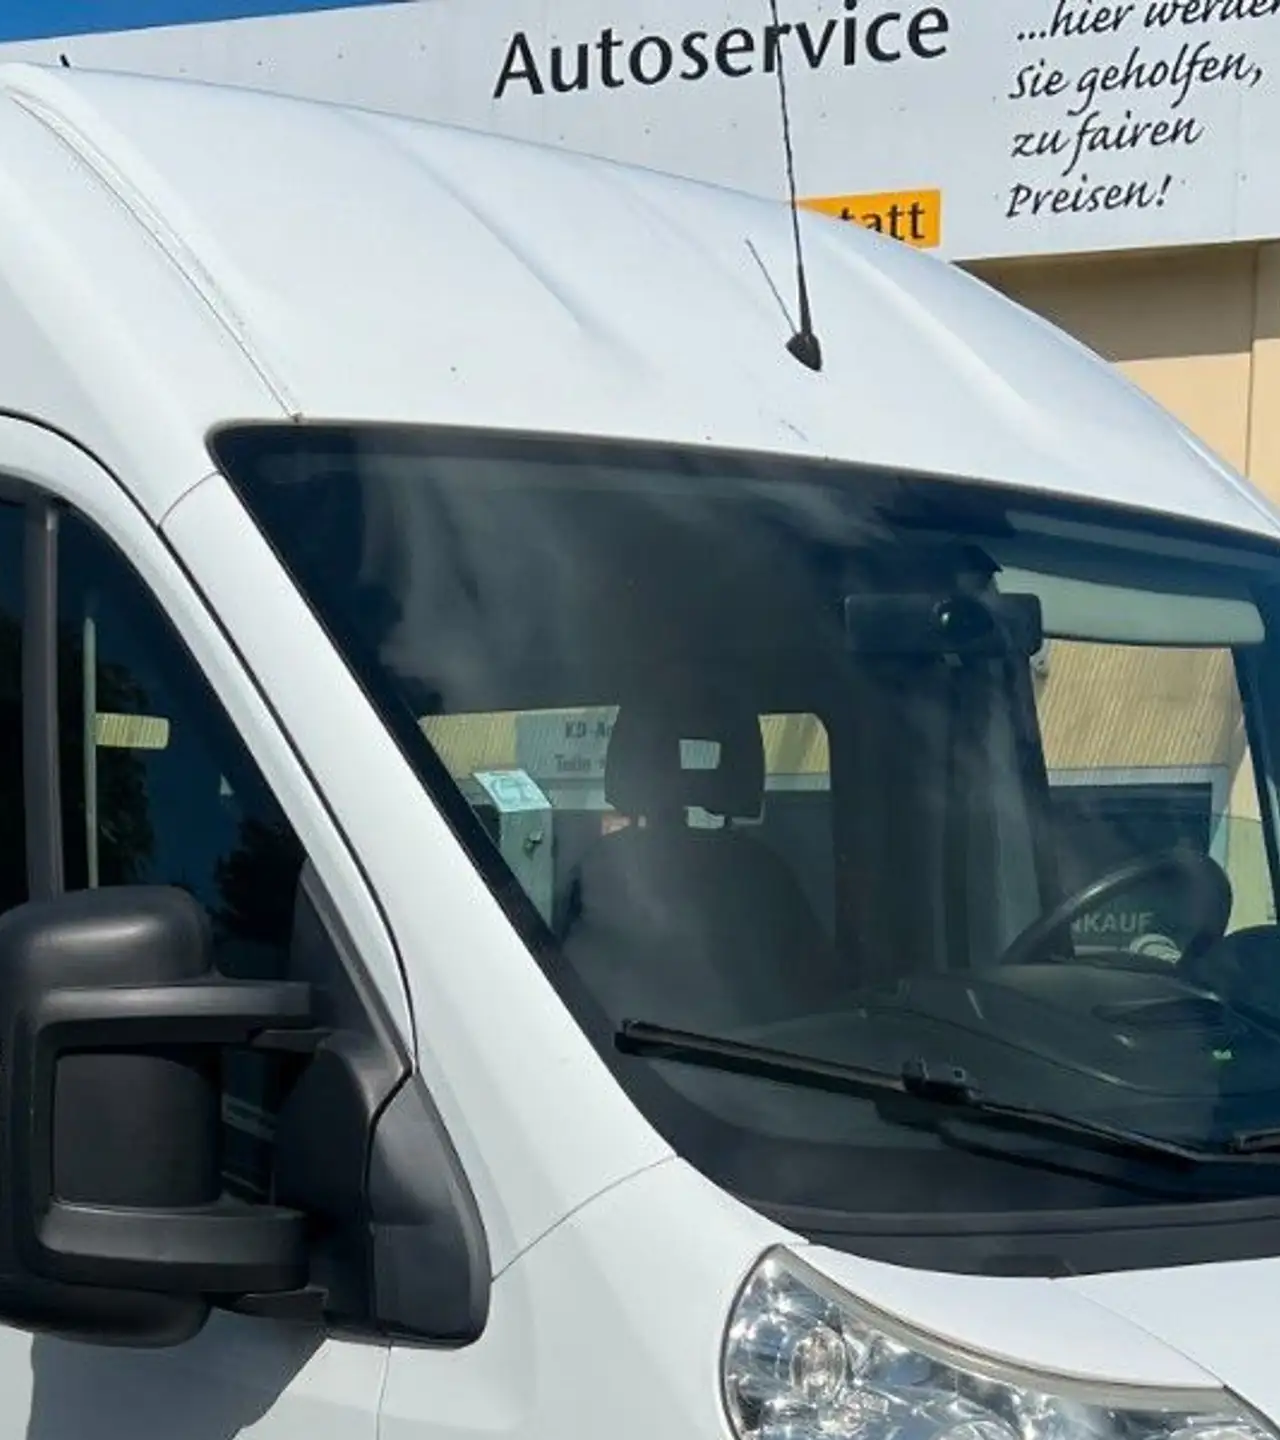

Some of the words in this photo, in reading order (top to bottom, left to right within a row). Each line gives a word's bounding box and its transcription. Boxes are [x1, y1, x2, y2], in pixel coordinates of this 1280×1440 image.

[493, 0, 950, 99] Autoservice
[1066, 41, 1263, 116] geholfen,
[1010, 129, 1070, 157] zu
[1062, 111, 1205, 177] fairen
[1005, 173, 1172, 218] Preisen!
